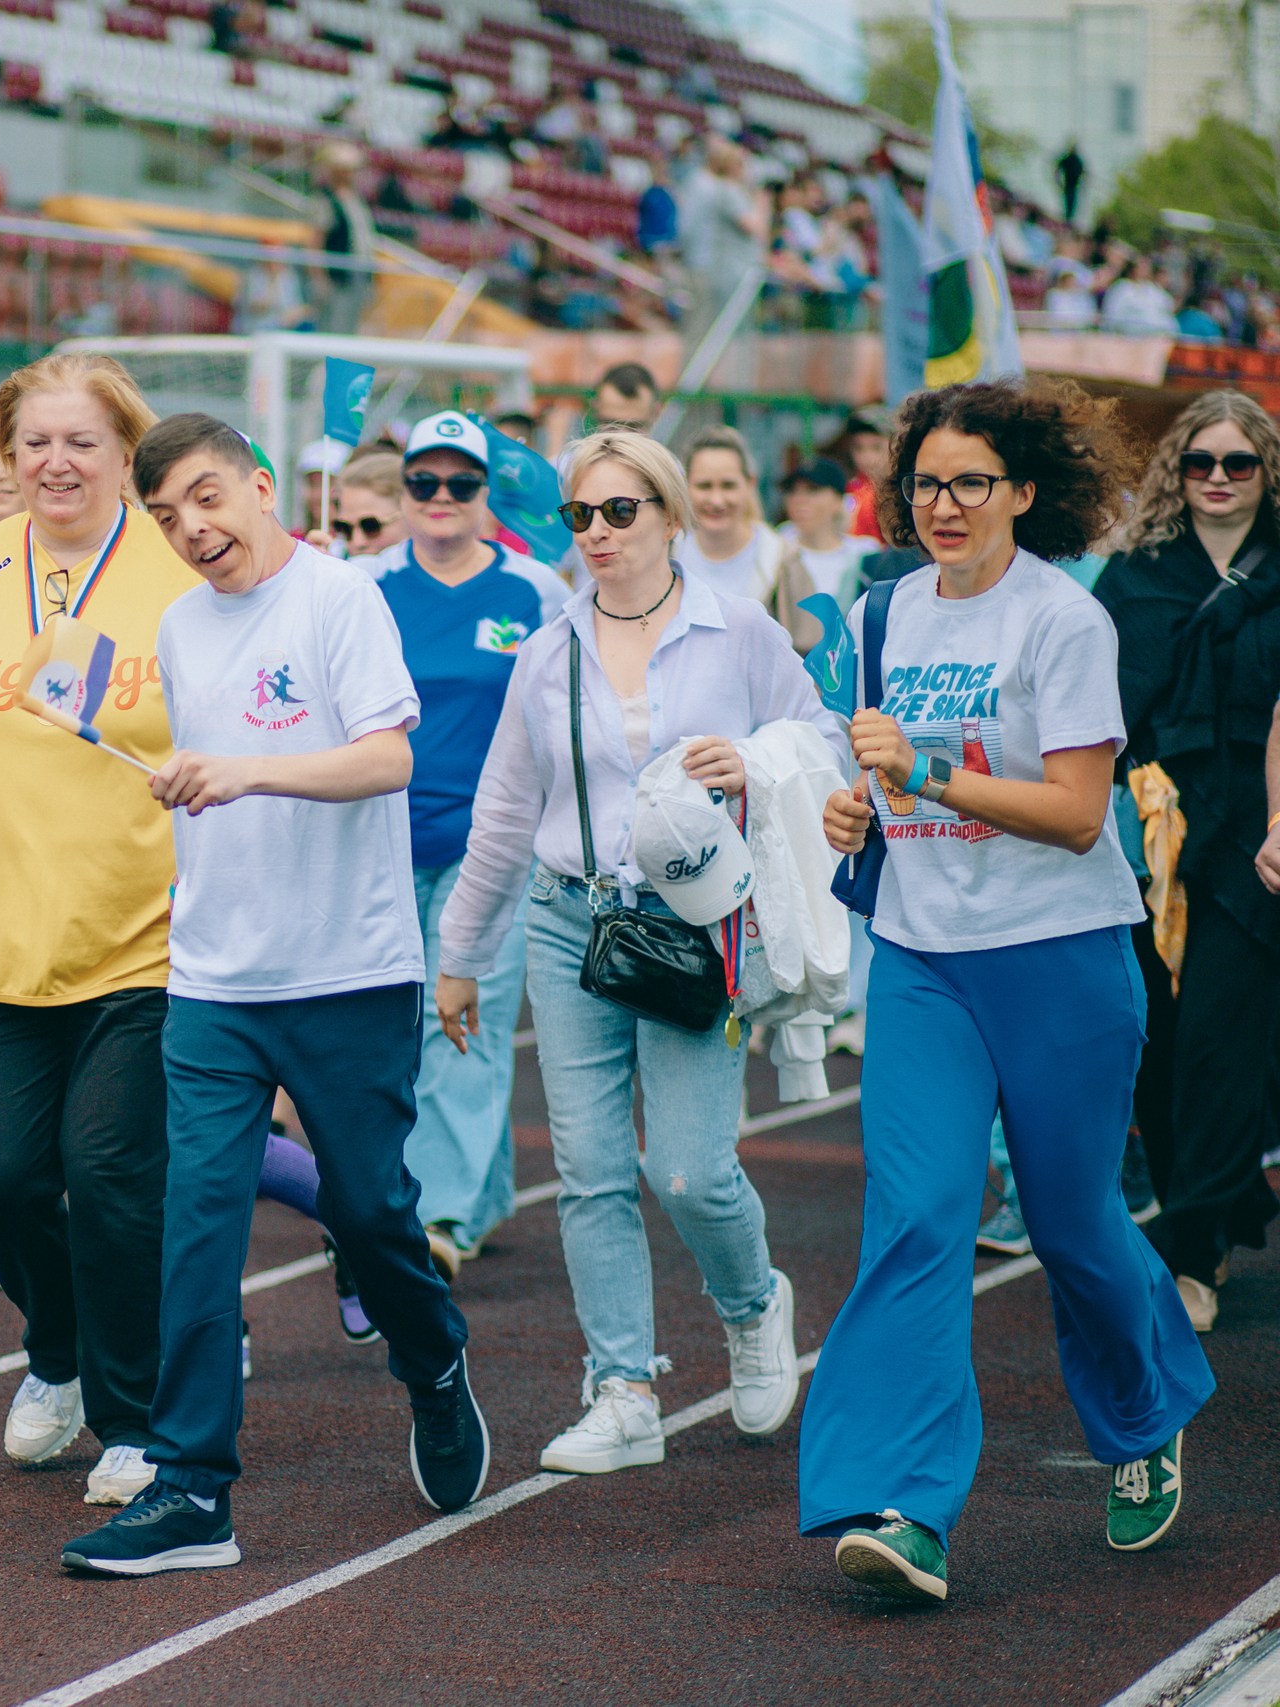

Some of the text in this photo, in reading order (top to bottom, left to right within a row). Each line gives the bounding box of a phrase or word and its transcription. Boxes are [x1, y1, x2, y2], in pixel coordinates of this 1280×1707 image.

[887, 662, 997, 695] PRACTICE
[242, 708, 310, 731] МИР ДЕТЯМ
[880, 694, 930, 723] AFE
[882, 823, 918, 840] WAYS
[920, 822, 937, 838] USE
[937, 822, 947, 838] A
